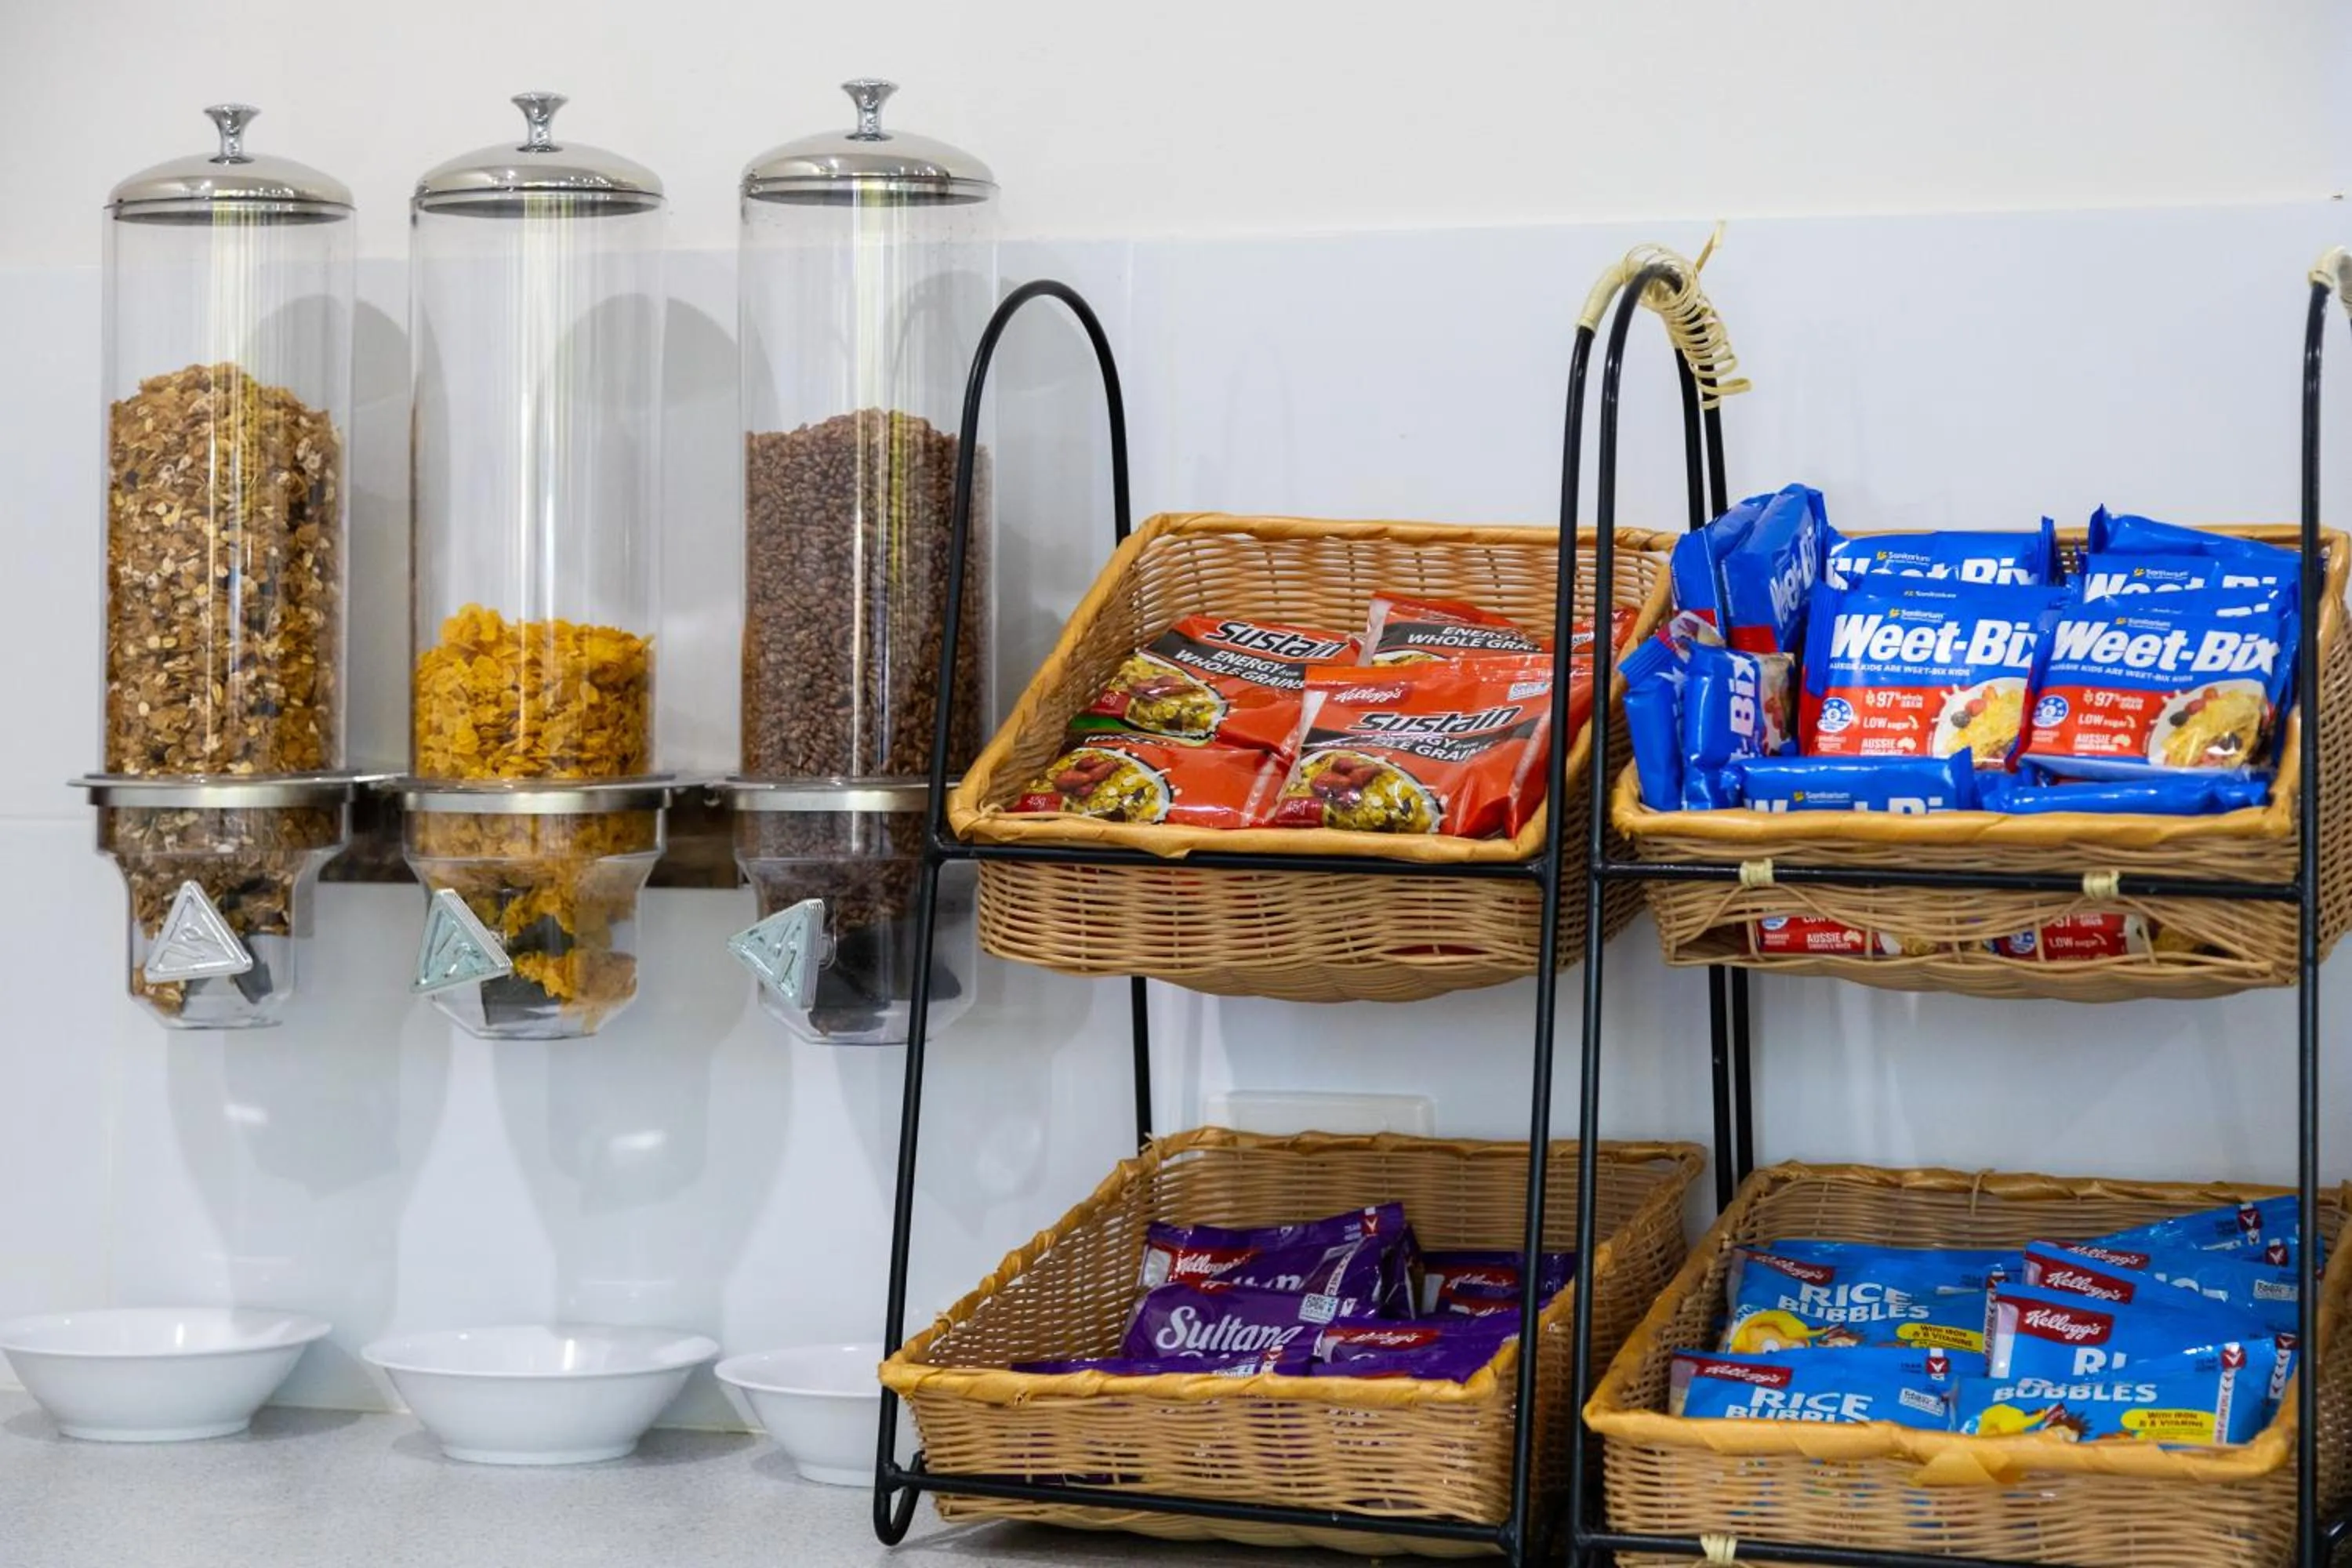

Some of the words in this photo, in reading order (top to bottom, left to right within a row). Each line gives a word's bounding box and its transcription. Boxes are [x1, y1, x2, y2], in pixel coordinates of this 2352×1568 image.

[1205, 620, 1351, 659] Sustain
[1408, 633, 1483, 647] WHOLE
[1486, 638, 1542, 652] GRA
[2051, 621, 2280, 676] Weet-Bix
[1174, 649, 1243, 677] WHOLE
[1240, 670, 1305, 690] GRAINS
[1214, 650, 1288, 673] ENERGY
[1334, 688, 1402, 703] Kellogg's
[1345, 705, 1523, 734] Sustain
[1863, 715, 1888, 728] LOW
[2078, 713, 2104, 725] LOW
[2048, 938, 2073, 949] LOW
[1798, 1282, 1913, 1308] RICE
[2045, 1271, 2121, 1301] Kellogg's
[1777, 1294, 1930, 1323] BUBBLES
[2025, 1308, 2102, 1340] Kellogg's
[1750, 1386, 1874, 1420] RICE
[1992, 1380, 2158, 1403] BUBBLES
